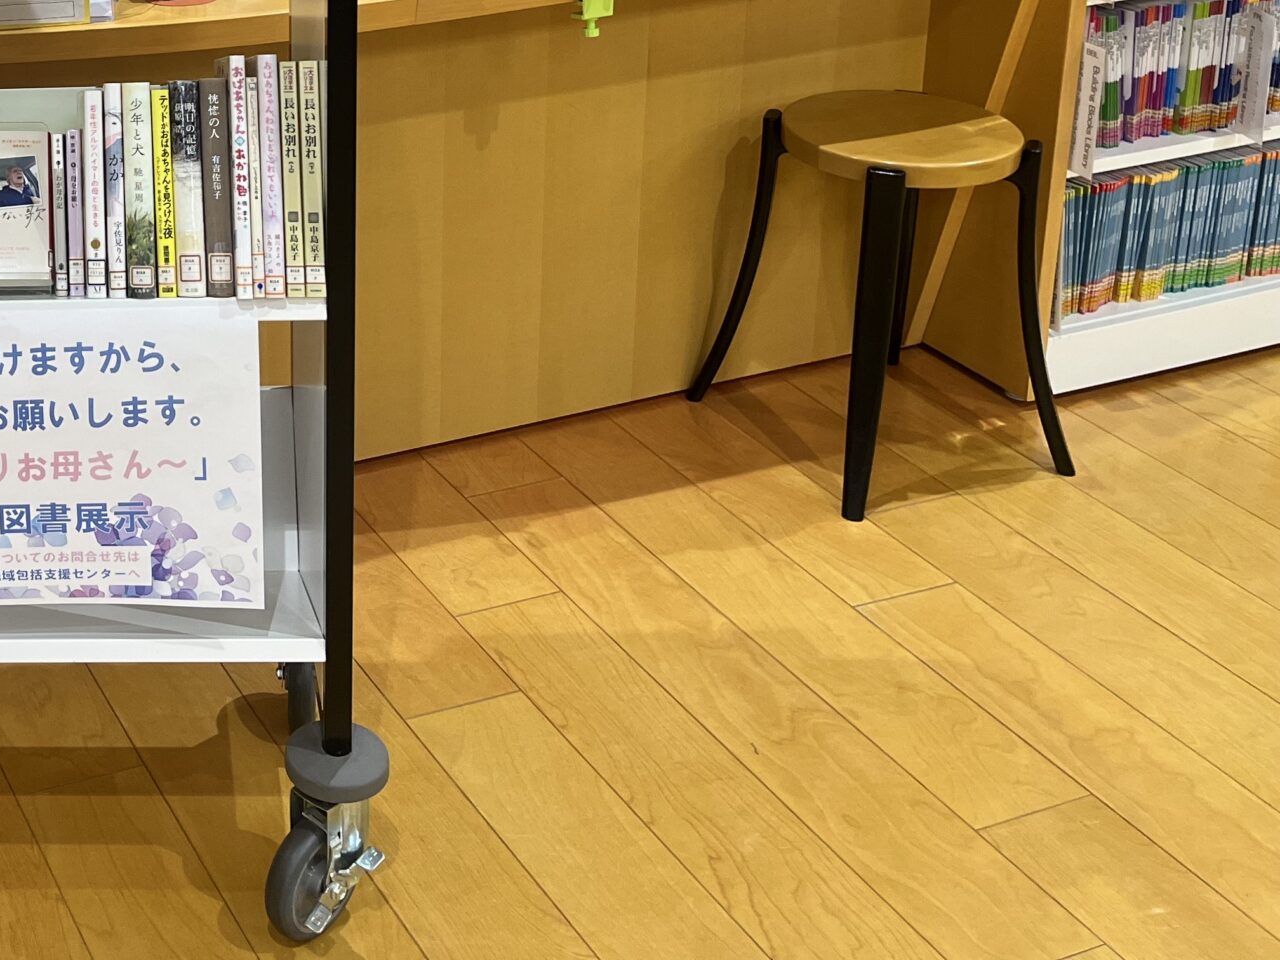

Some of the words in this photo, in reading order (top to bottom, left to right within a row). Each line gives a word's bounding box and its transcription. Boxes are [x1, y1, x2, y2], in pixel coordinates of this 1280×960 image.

[231, 66, 246, 136] おばあちゃん
[1088, 65, 1100, 103] Building
[128, 97, 145, 157] 少年と犬
[183, 102, 197, 156] 明日の記憶
[207, 93, 221, 139] 恍惚の人
[283, 97, 297, 158] 長いお別れ
[303, 98, 317, 159] 長いお別れ
[1084, 104, 1096, 136] Blocks
[89, 105, 100, 228] 若年性アルツハイマーの母と生きる
[158, 95, 174, 239] テッドがおばあちゃんを見つけた夜
[234, 149, 249, 197] あかね色
[1080, 137, 1092, 170] Library
[55, 175, 64, 210] わが母の記
[133, 167, 144, 203] 馳星周
[211, 155, 222, 200] 有吉佐和子
[113, 220, 124, 264] 宇佐見りん
[286, 225, 299, 261] 中島京子
[308, 226, 320, 262] 中島京子
